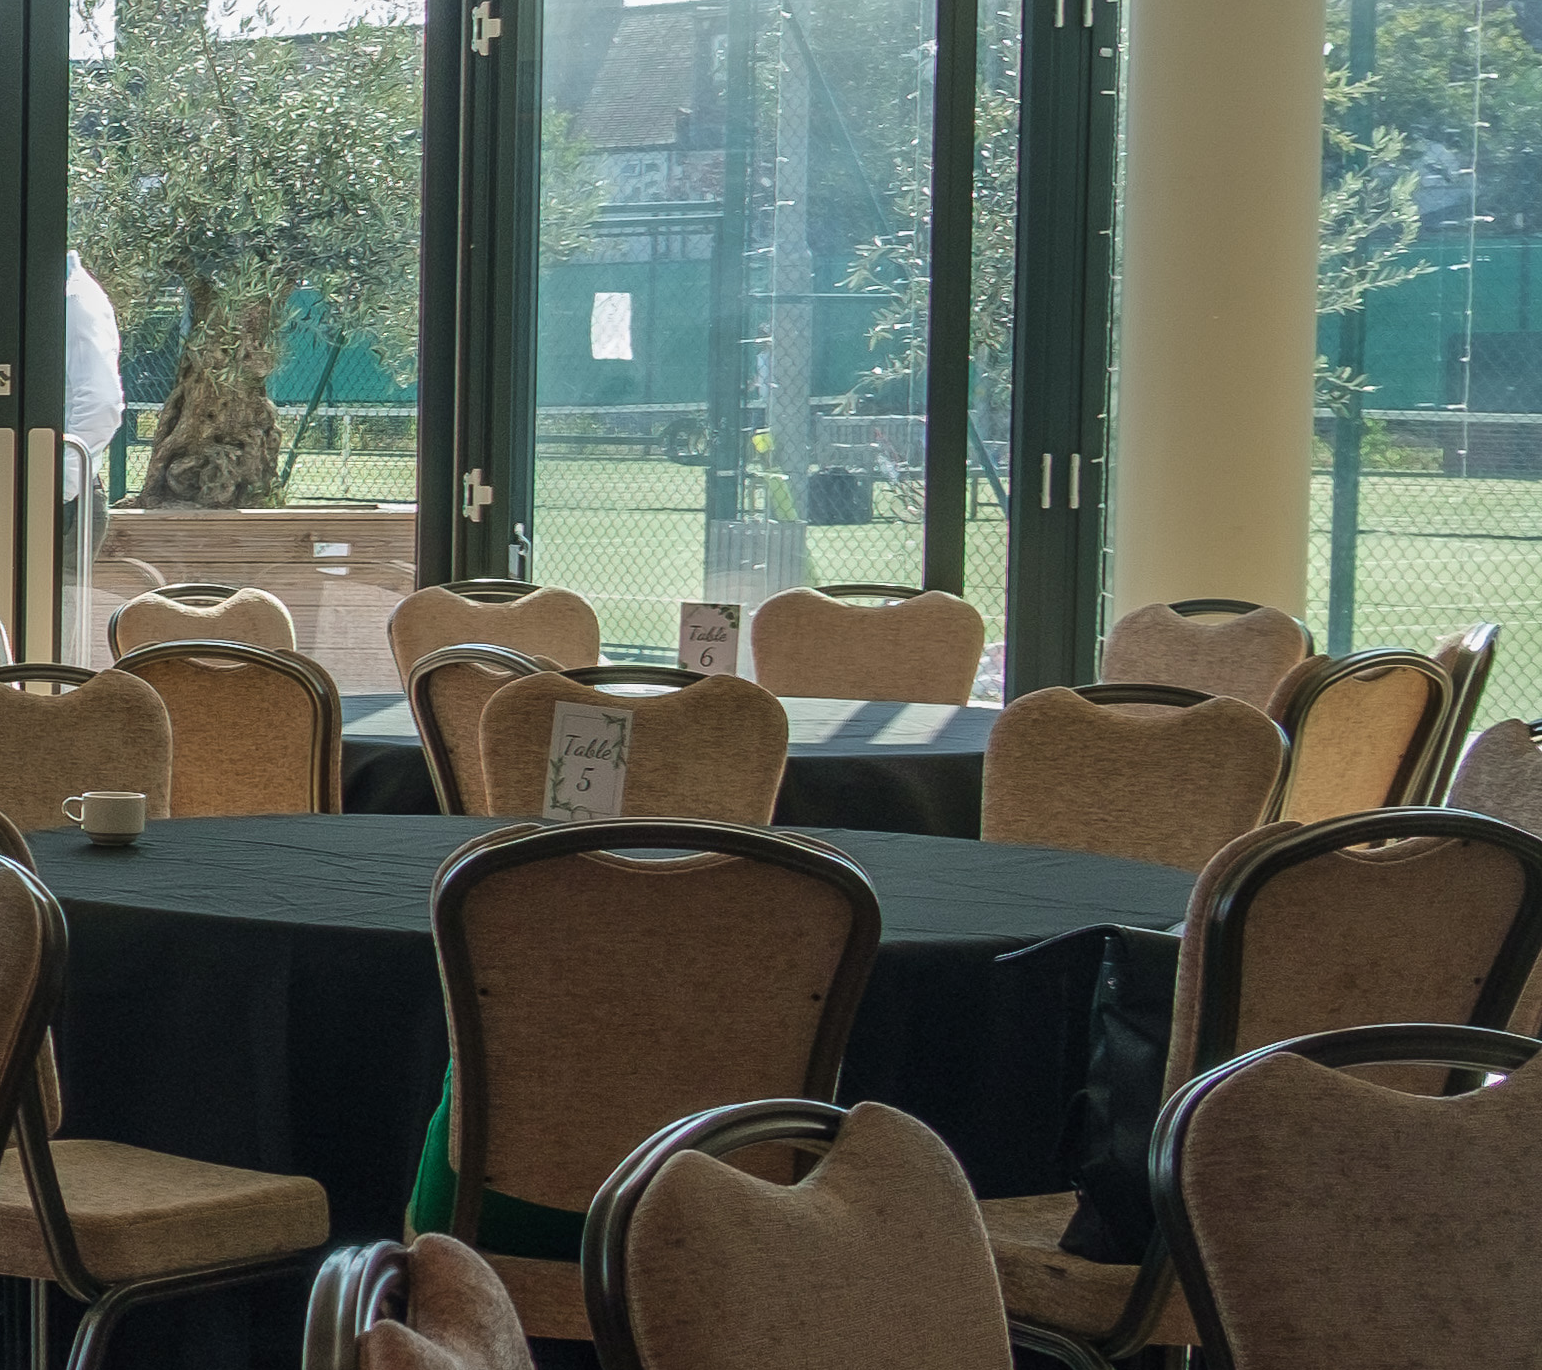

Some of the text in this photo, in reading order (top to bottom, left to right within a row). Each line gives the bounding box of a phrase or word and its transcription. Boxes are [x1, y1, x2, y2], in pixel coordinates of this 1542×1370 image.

[689, 625, 727, 643] Table
[700, 646, 716, 667] 6
[564, 734, 612, 761] Table
[576, 767, 594, 792] 5
